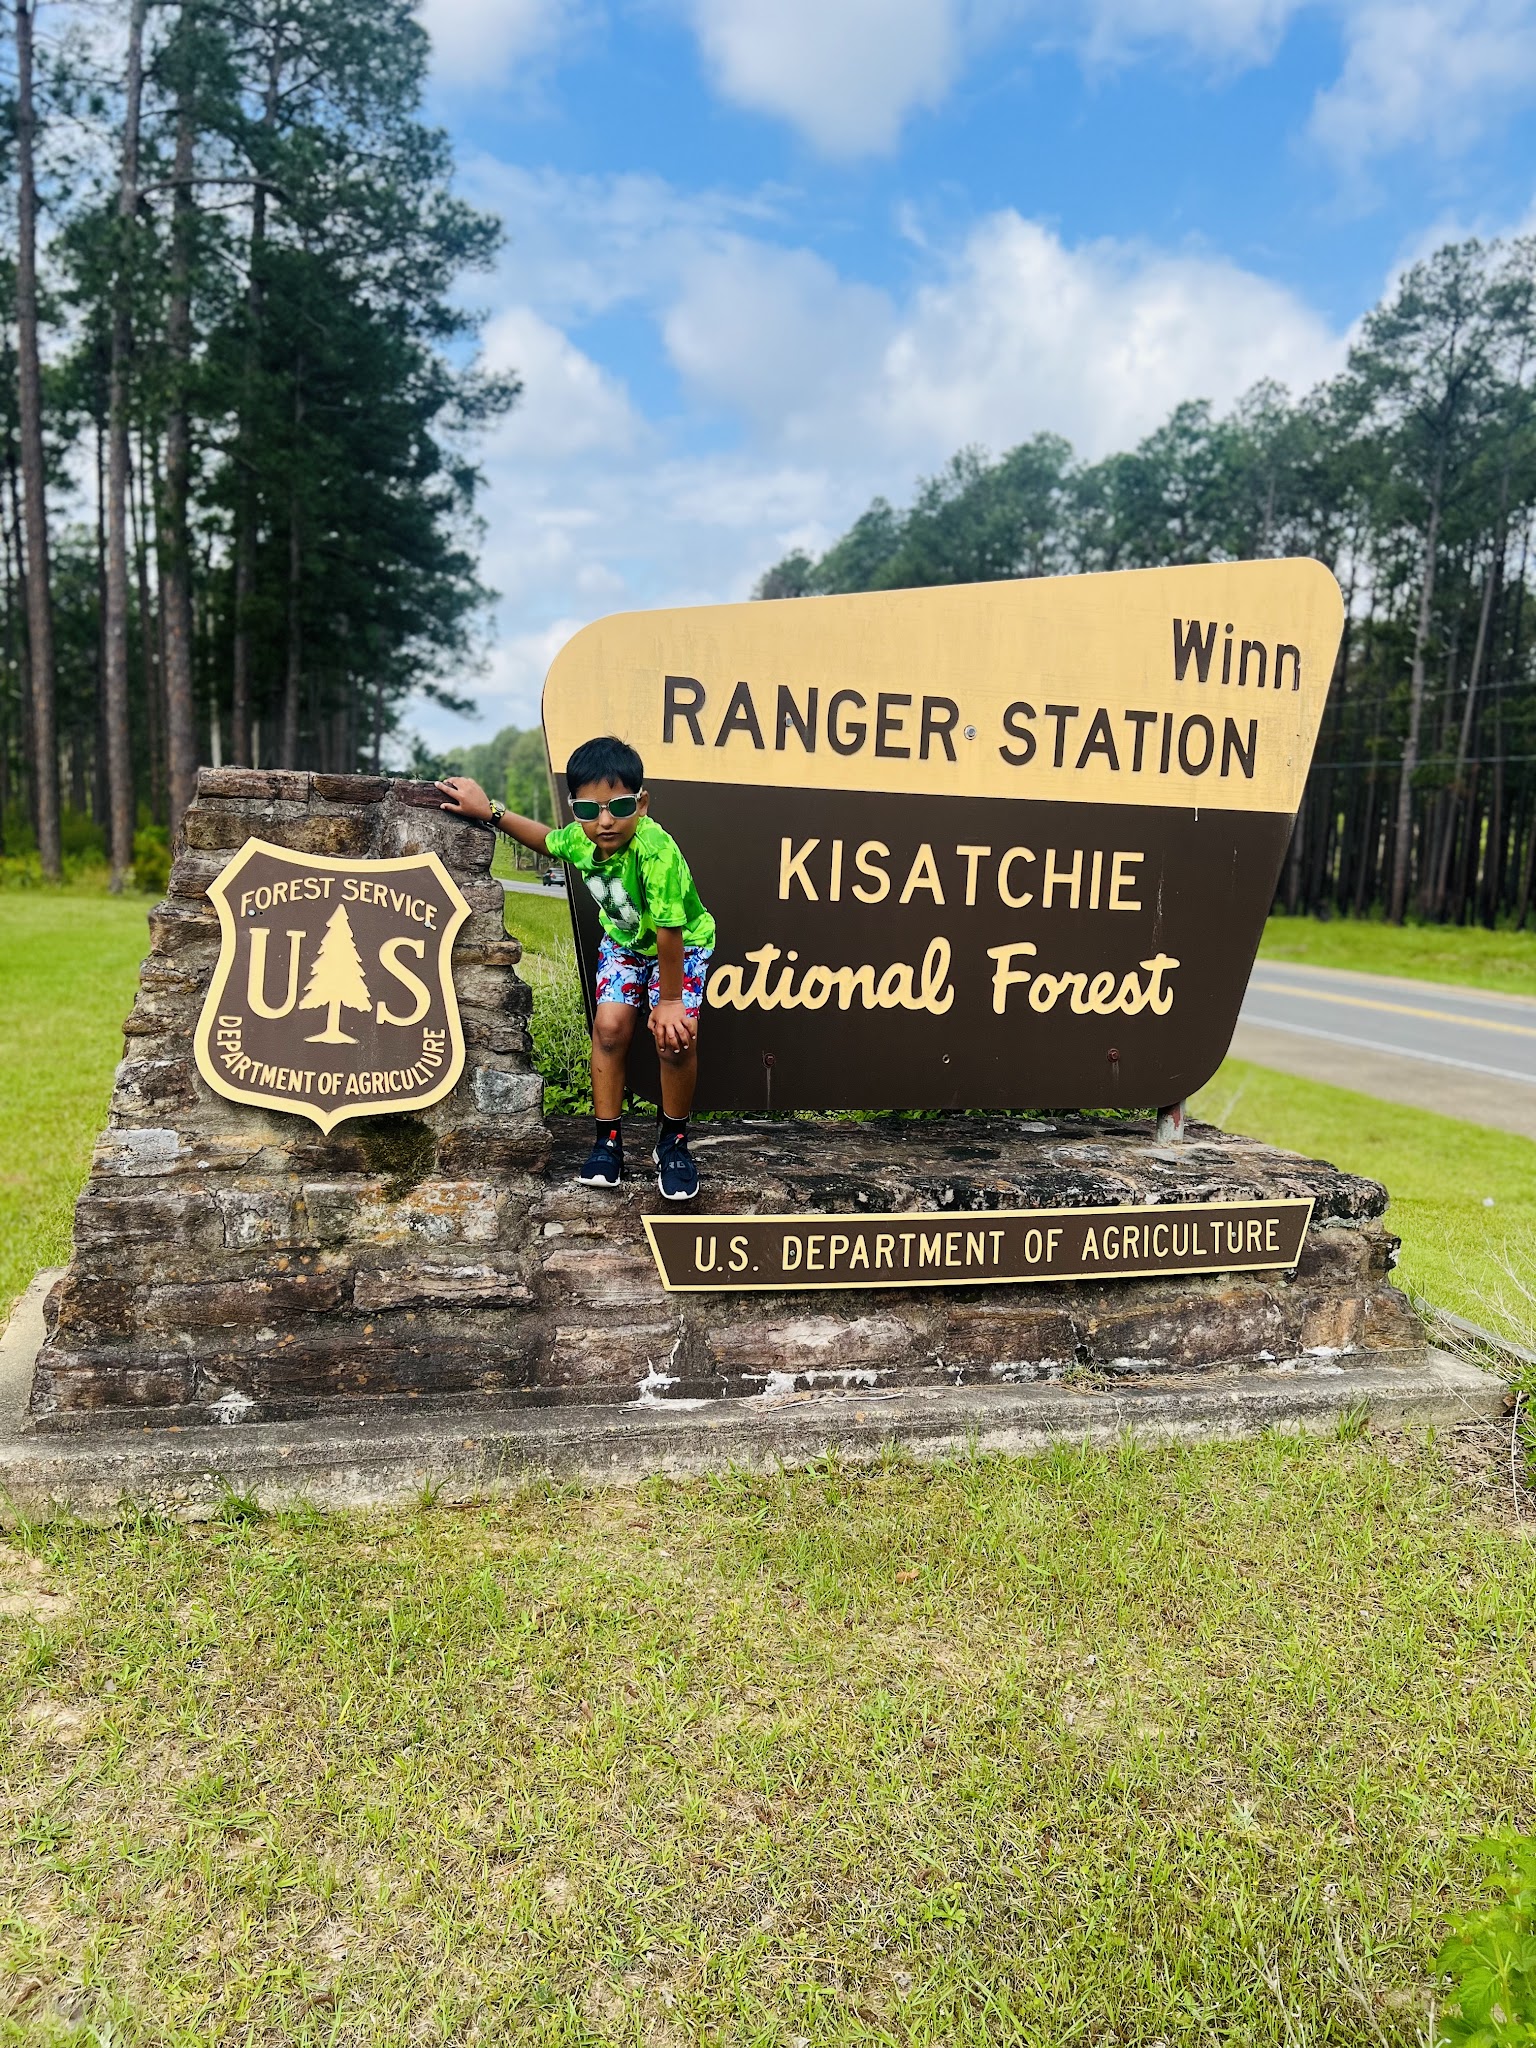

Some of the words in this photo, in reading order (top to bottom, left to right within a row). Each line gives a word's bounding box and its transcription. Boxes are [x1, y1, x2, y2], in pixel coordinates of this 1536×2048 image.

[1172, 618, 1301, 691] Winn
[663, 674, 960, 762] RANGER
[998, 702, 1258, 779] STATION
[240, 877, 336, 918] FOREST
[341, 878, 438, 931] SERVICE
[778, 837, 1145, 911] KISATCHIE
[247, 927, 307, 1020] U
[376, 936, 431, 1027] S
[706, 936, 956, 1016] ational
[986, 942, 1181, 1016] Forest
[216, 1014, 316, 1095] DEPARTMENT
[317, 1072, 344, 1095] OF
[344, 1027, 446, 1096] AGRICULTURE
[694, 1236, 759, 1273] U.S.
[781, 1231, 1006, 1271] DEPARTMENT
[1024, 1228, 1064, 1265] OF
[1080, 1218, 1281, 1262] AGRICULTURE
